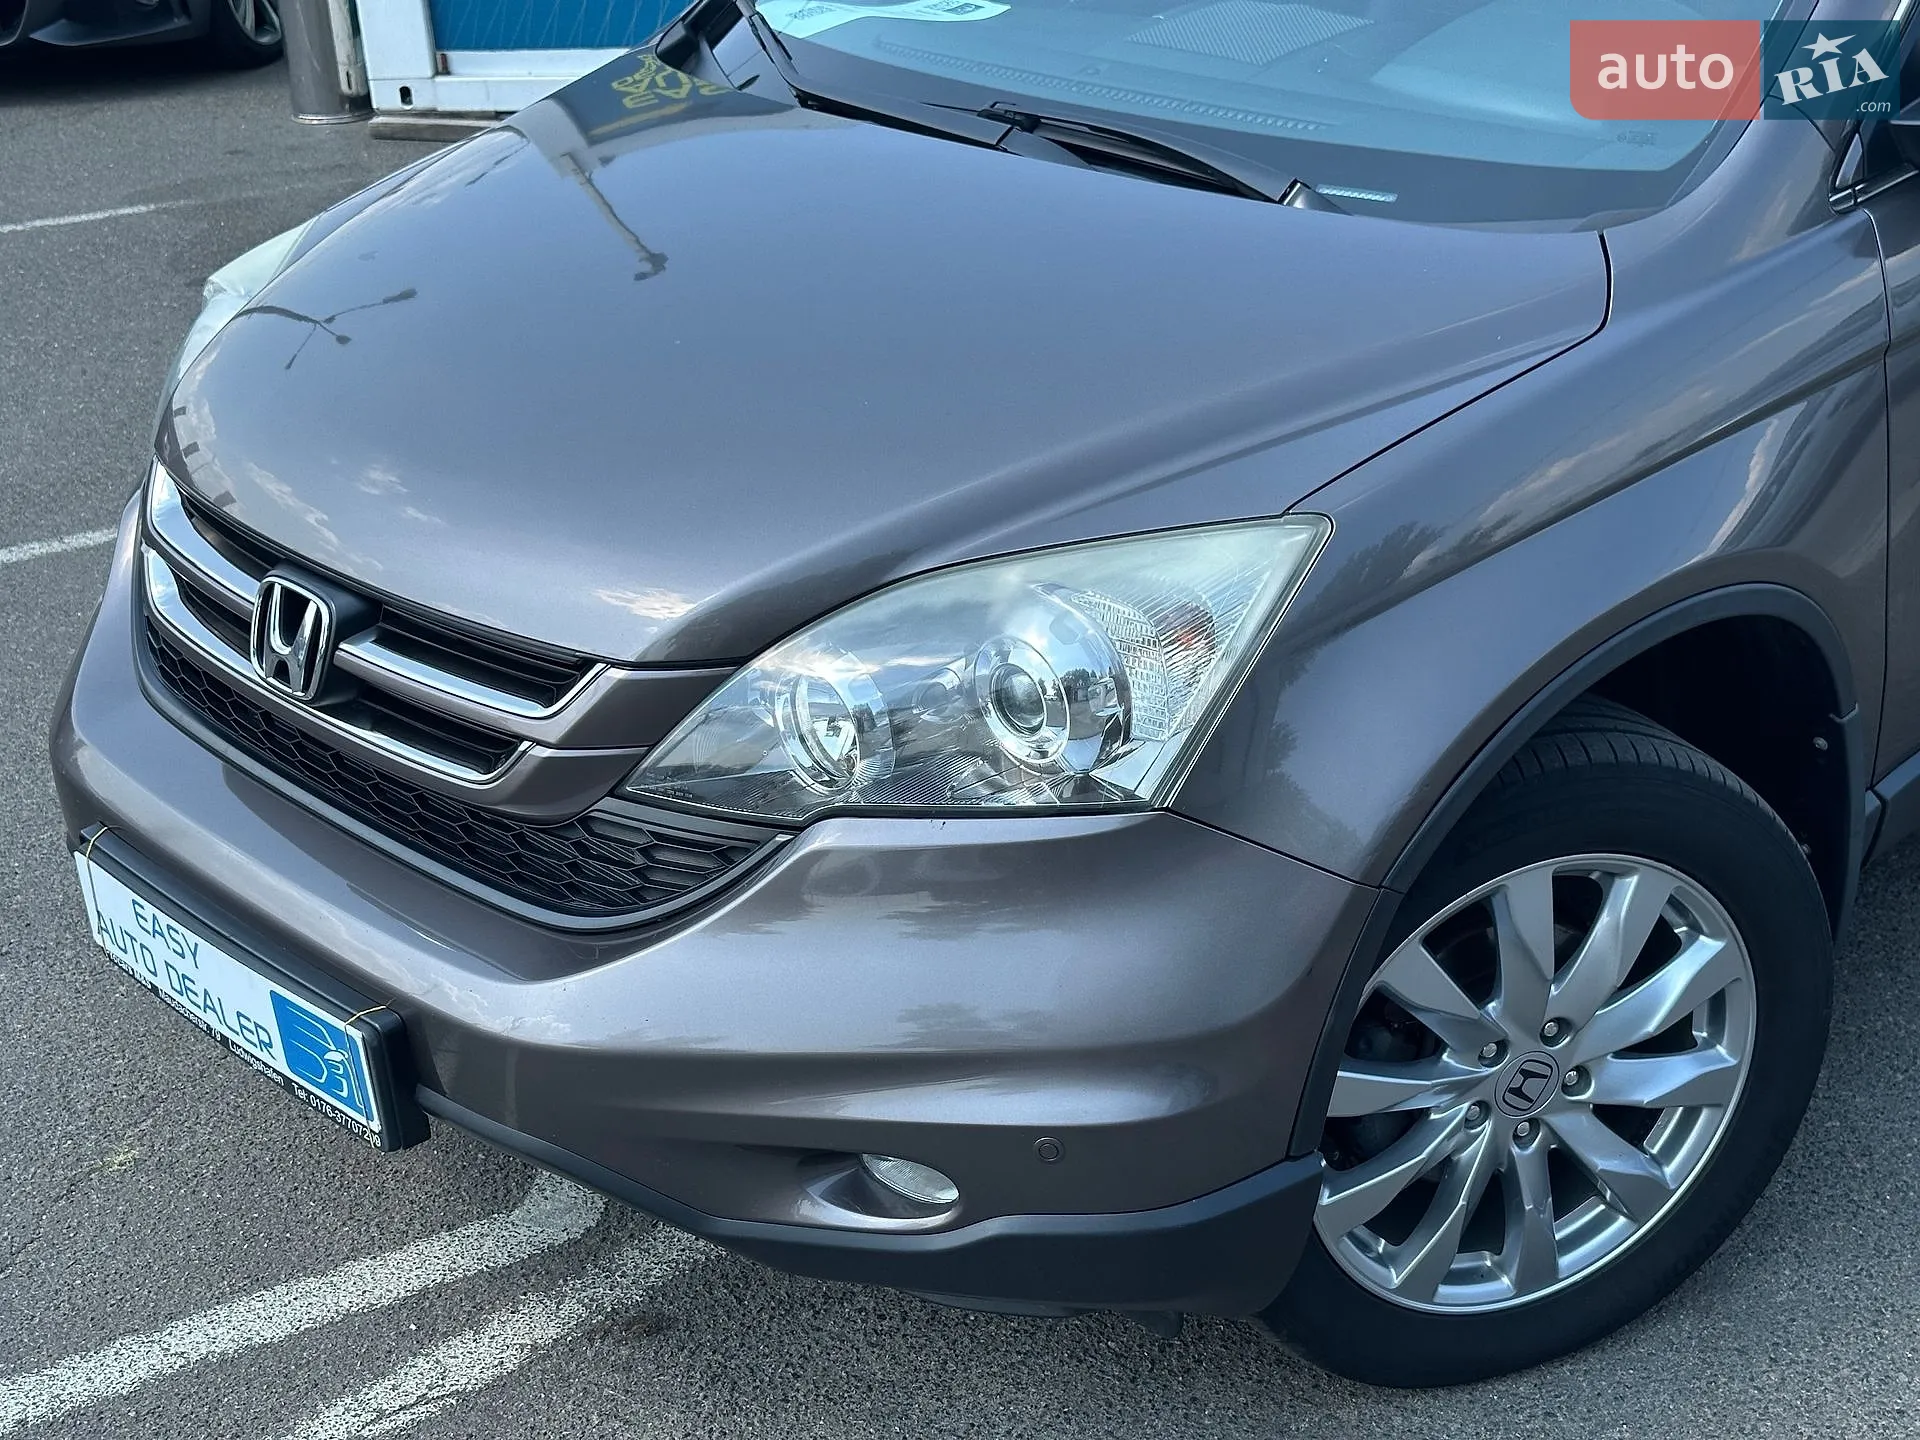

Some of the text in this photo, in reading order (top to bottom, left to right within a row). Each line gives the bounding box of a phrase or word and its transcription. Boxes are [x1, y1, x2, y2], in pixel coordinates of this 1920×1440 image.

[97, 910, 277, 1061] AUTO DEALER
[131, 898, 199, 970] EASY
